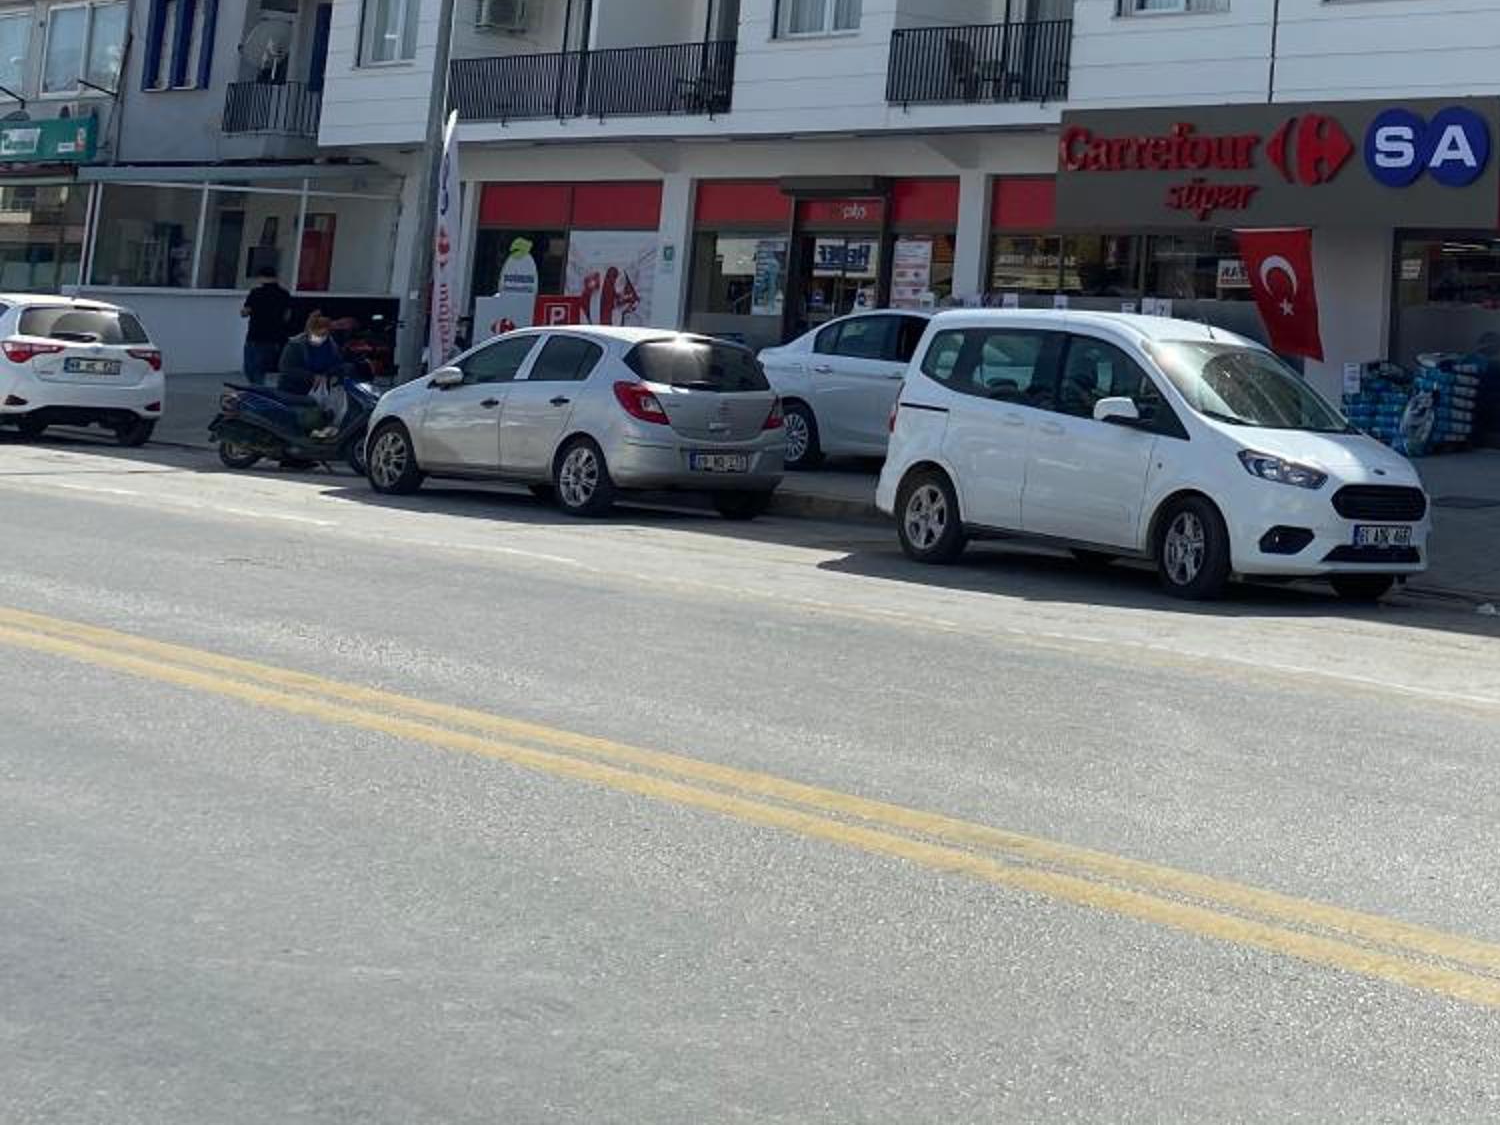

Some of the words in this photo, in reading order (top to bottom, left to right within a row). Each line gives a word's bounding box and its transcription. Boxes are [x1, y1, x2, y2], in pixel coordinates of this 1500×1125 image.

[1060, 121, 1260, 172] Carrefour
[1374, 124, 1478, 168] SA
[1165, 178, 1259, 221] süper
[551, 305, 566, 324] P
